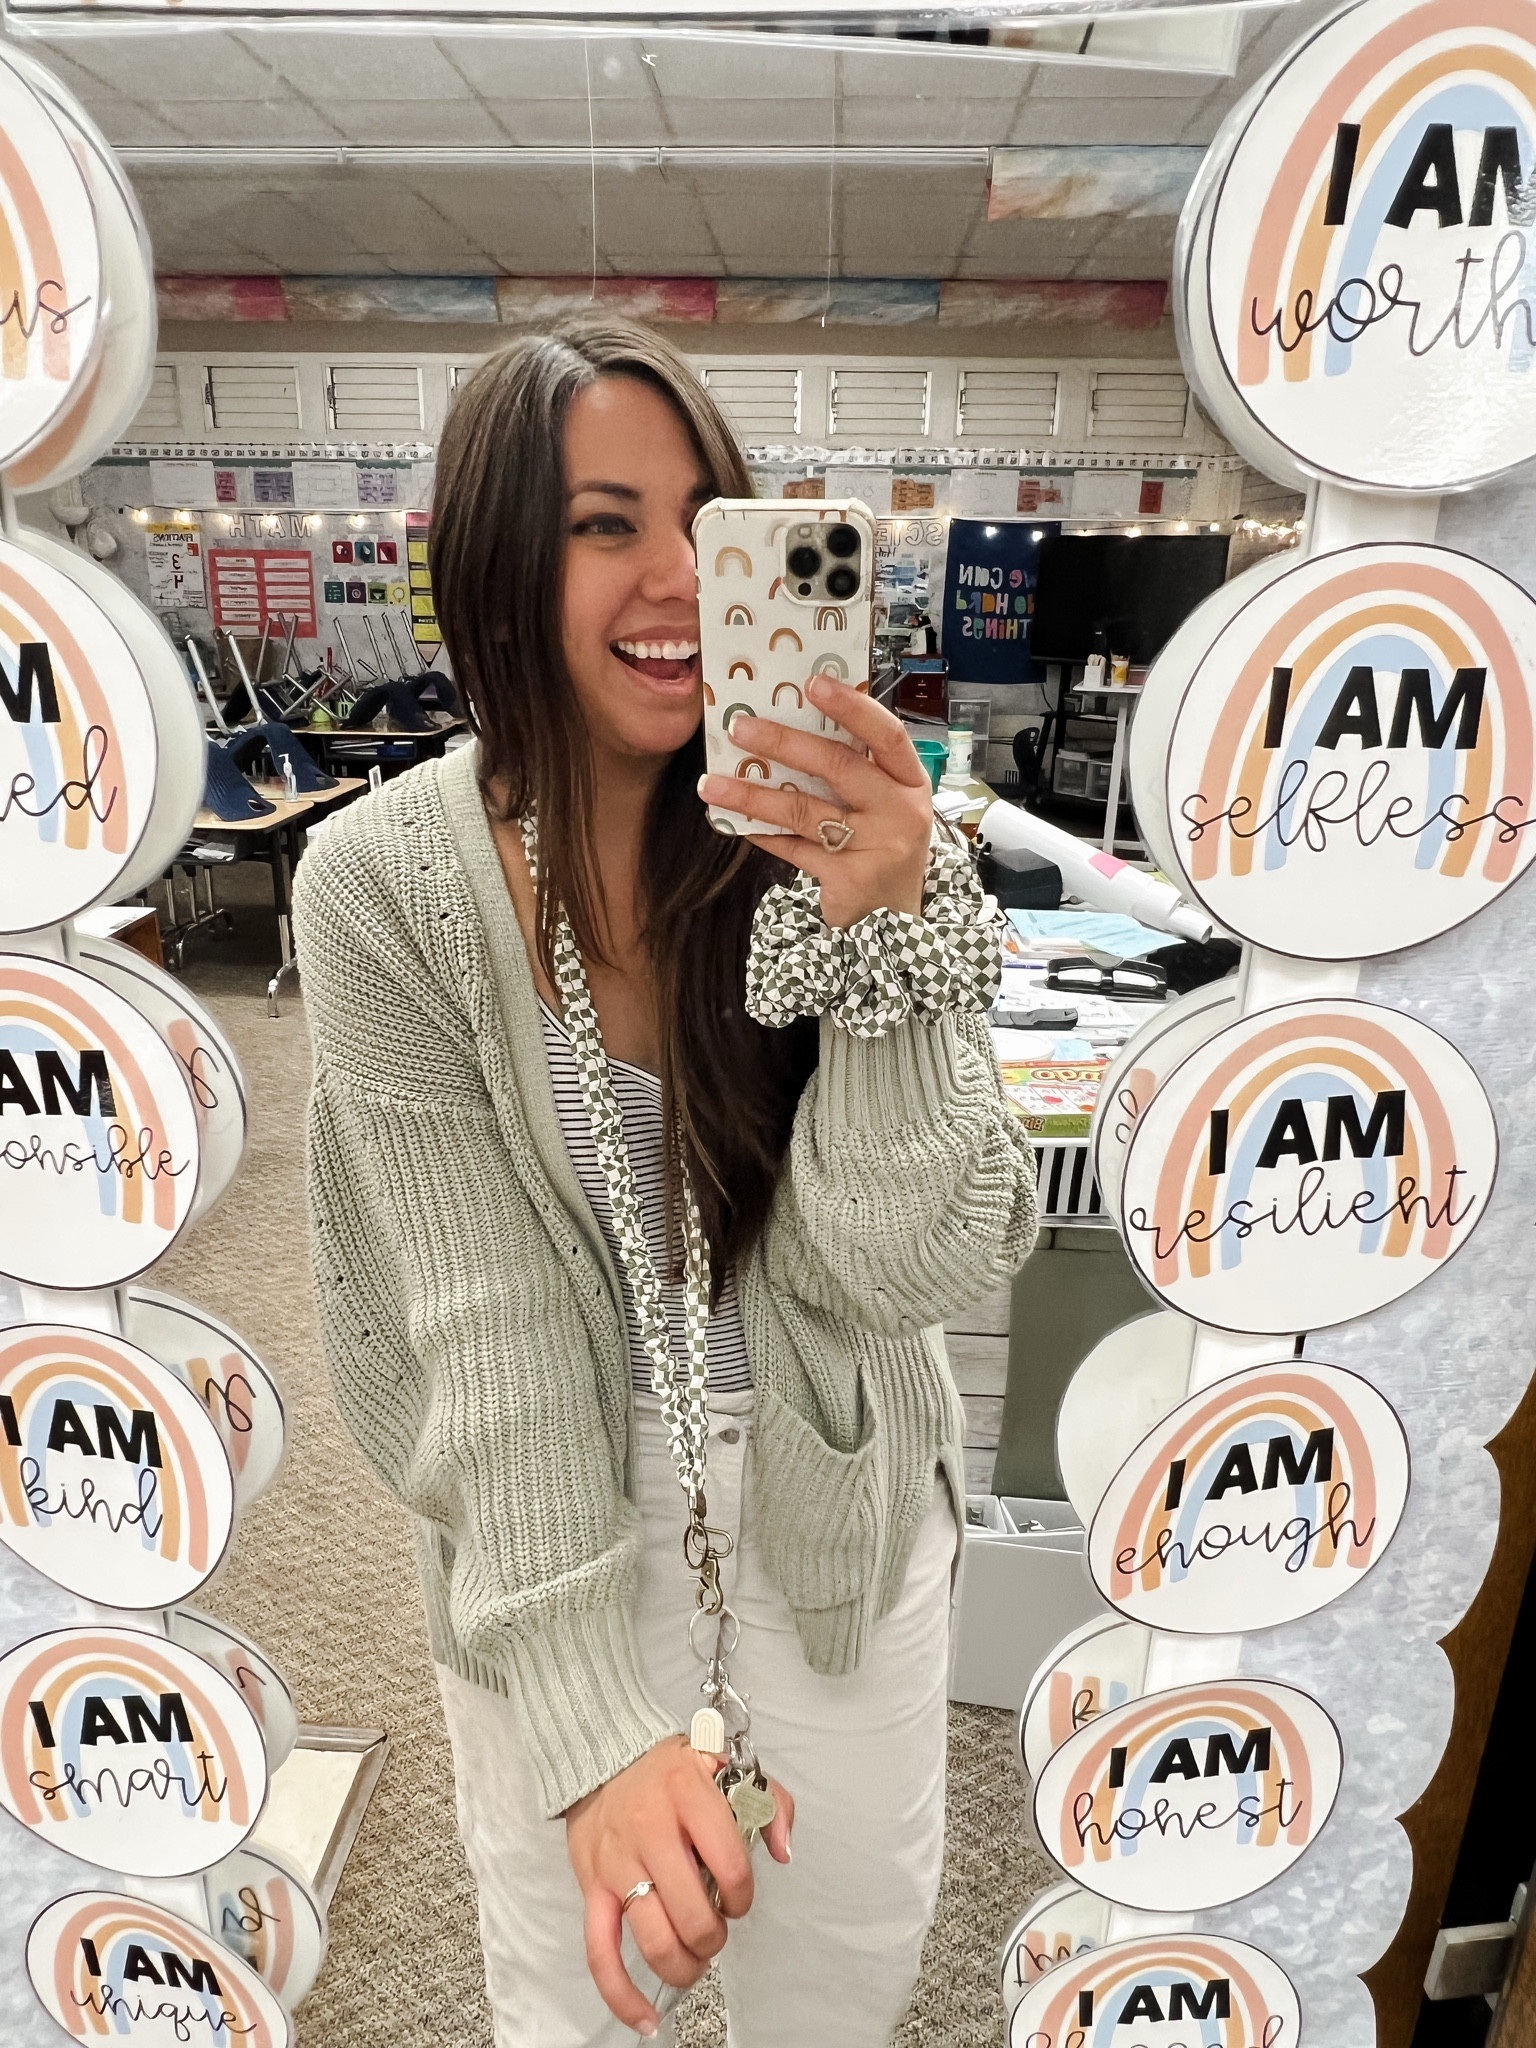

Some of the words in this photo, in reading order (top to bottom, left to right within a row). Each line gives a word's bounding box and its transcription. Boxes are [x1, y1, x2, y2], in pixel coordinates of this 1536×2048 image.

[1323, 122, 1361, 226] I
[1264, 666, 1293, 749] I
[1315, 666, 1488, 750] AM
[1181, 759, 1536, 852] selfless
[1208, 1108, 1230, 1176] I
[1255, 1089, 1406, 1169] AM
[1130, 1165, 1476, 1260] resilient
[0, 1395, 22, 1446] I
[47, 1398, 163, 1468] AM
[1164, 1458, 1187, 1511] I
[1204, 1427, 1334, 1500] AM
[20, 1456, 163, 1538] kind
[1116, 1481, 1376, 1573] enough
[28, 1700, 55, 1748] I
[80, 1692, 194, 1746] AM
[1108, 1746, 1127, 1788] I
[1148, 1726, 1271, 1784] AM
[29, 1751, 228, 1807] smart
[1073, 1778, 1303, 1848] honest
[80, 1937, 102, 1977] I
[123, 1944, 223, 1997] AM
[1078, 1990, 1094, 2027] I
[1116, 1978, 1230, 2025] AM
[70, 1984, 257, 2042] unique
